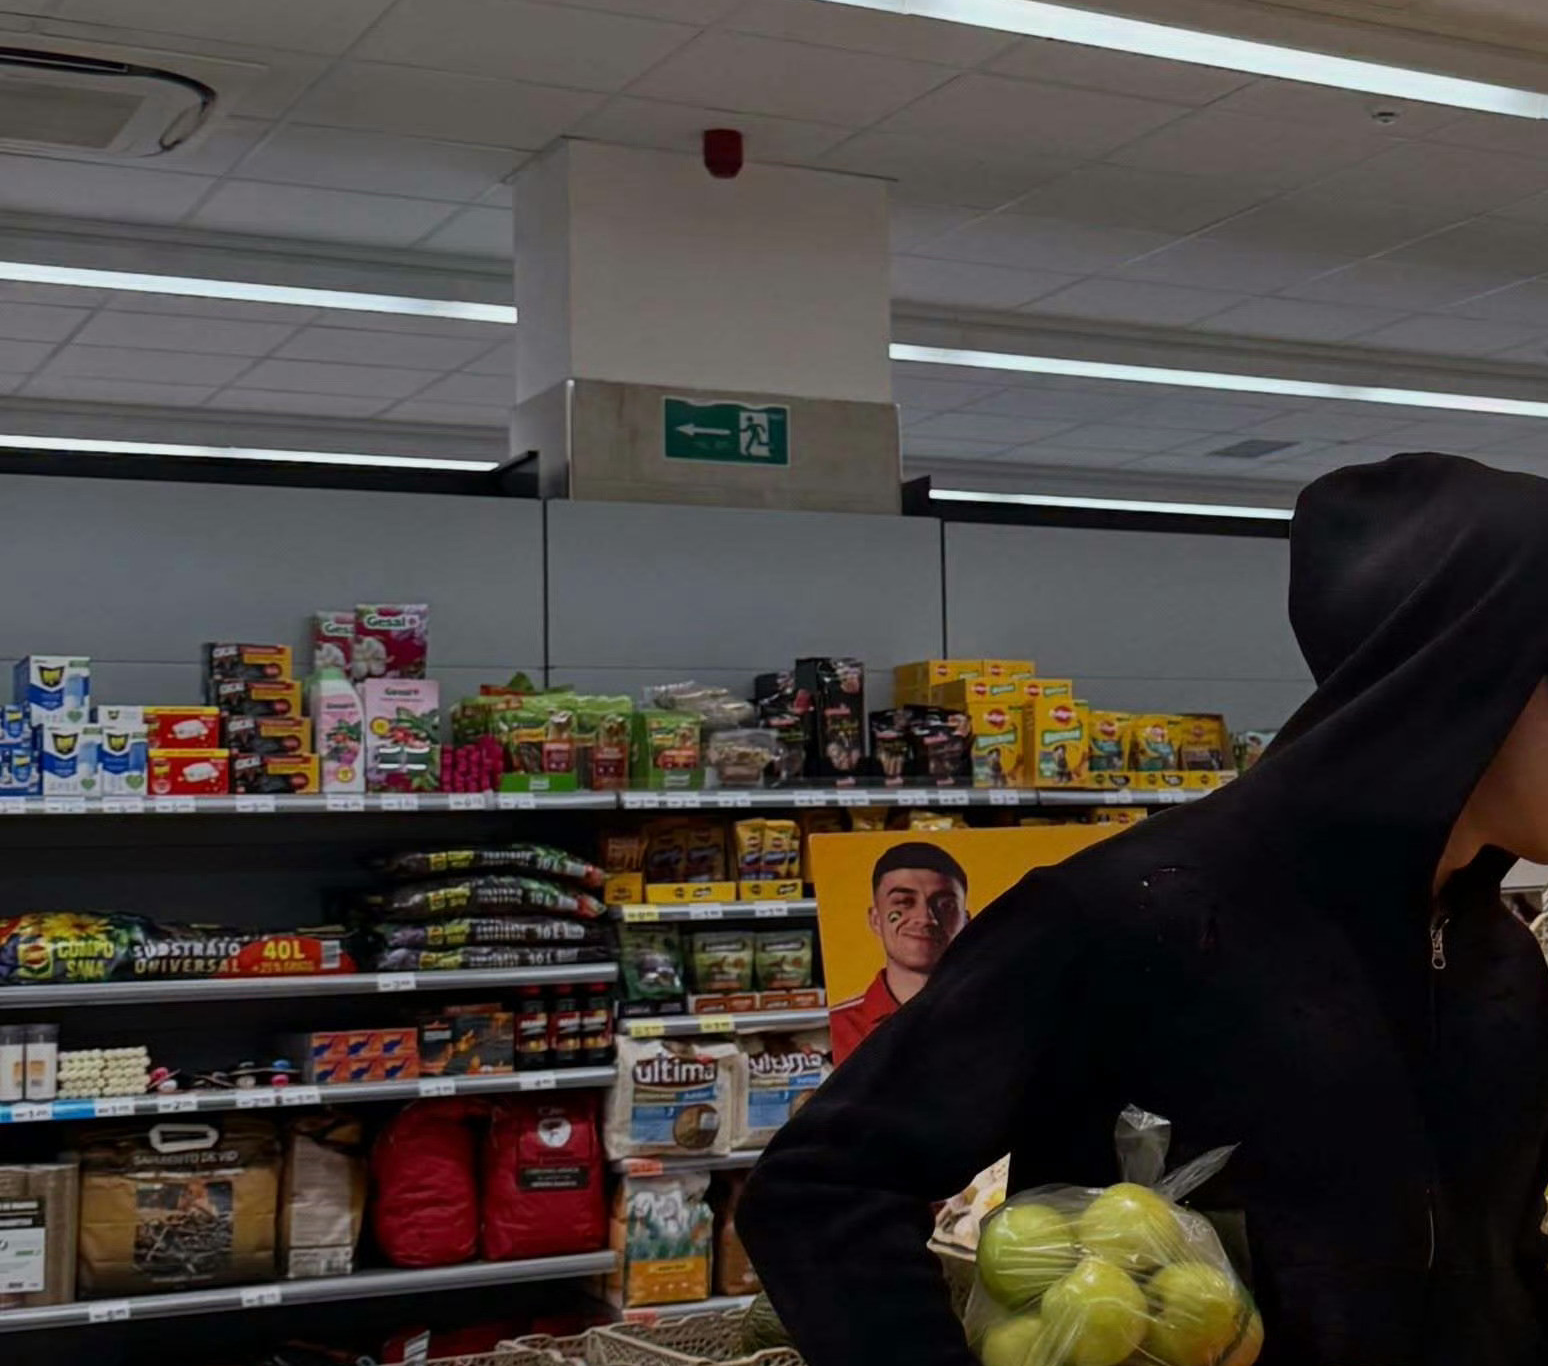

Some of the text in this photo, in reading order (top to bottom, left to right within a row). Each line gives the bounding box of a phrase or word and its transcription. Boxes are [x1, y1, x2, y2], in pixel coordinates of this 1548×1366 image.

[325, 622, 354, 634] Ges
[366, 615, 407, 628] Gesal
[58, 942, 114, 959] COMPO
[133, 938, 241, 959] SUBSTRATO
[66, 961, 105, 979] SANA
[134, 958, 241, 974] UNIVERSAL
[635, 1053, 716, 1084] ultima
